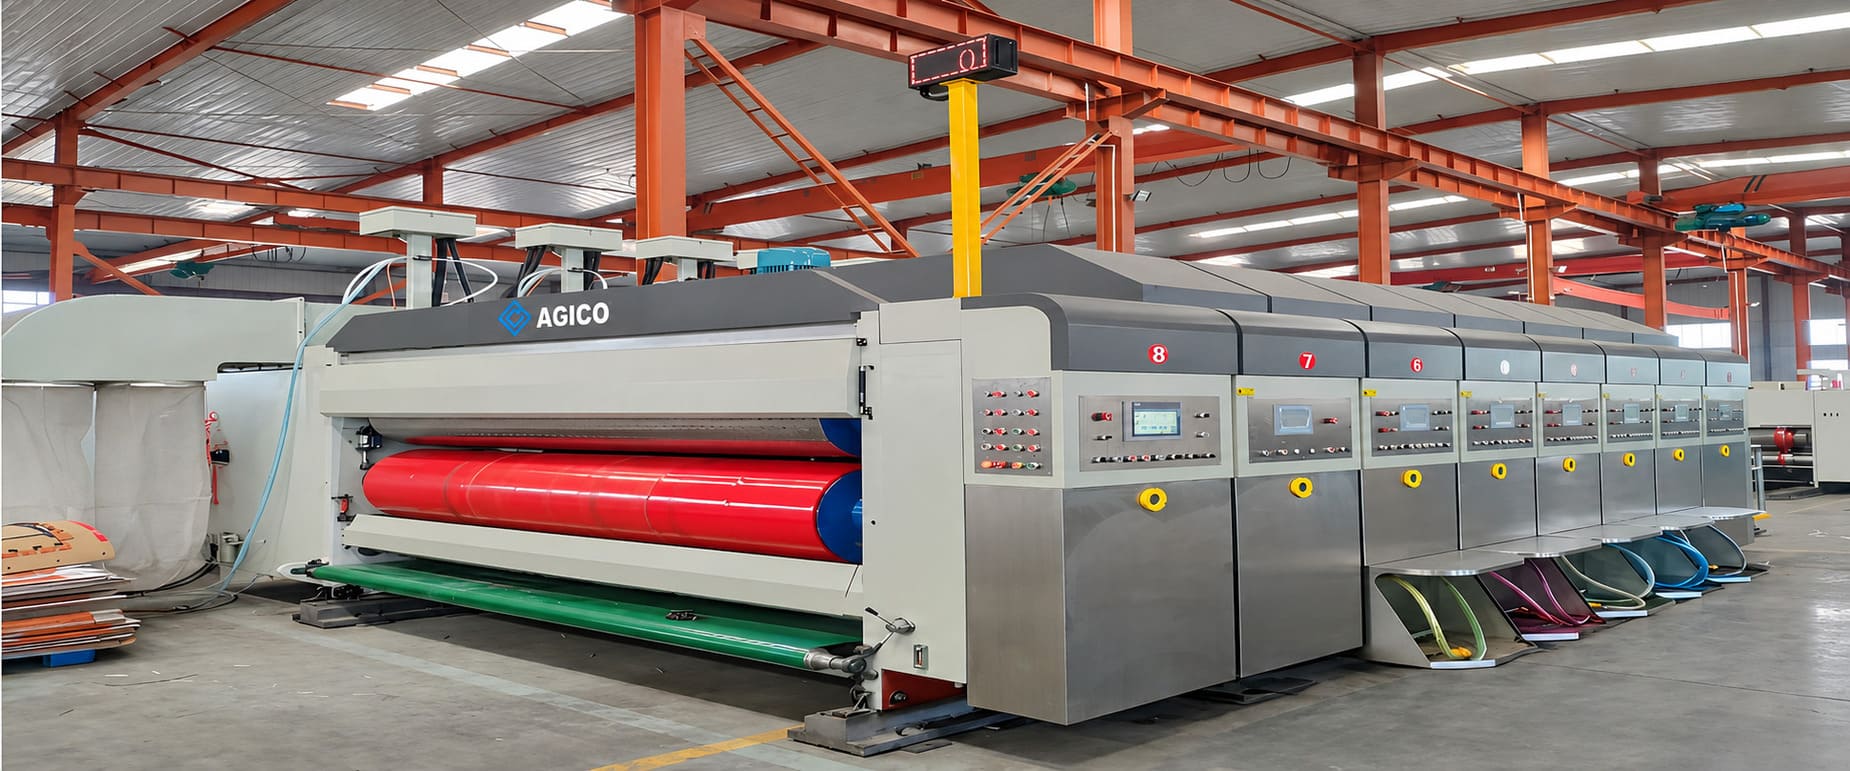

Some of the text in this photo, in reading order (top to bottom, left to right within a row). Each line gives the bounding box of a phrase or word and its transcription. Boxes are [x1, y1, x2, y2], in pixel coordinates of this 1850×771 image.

[536, 302, 610, 329] AGICO
[1152, 346, 1166, 363] 8
[1303, 354, 1313, 369] 7
[1413, 359, 1422, 372] 6
